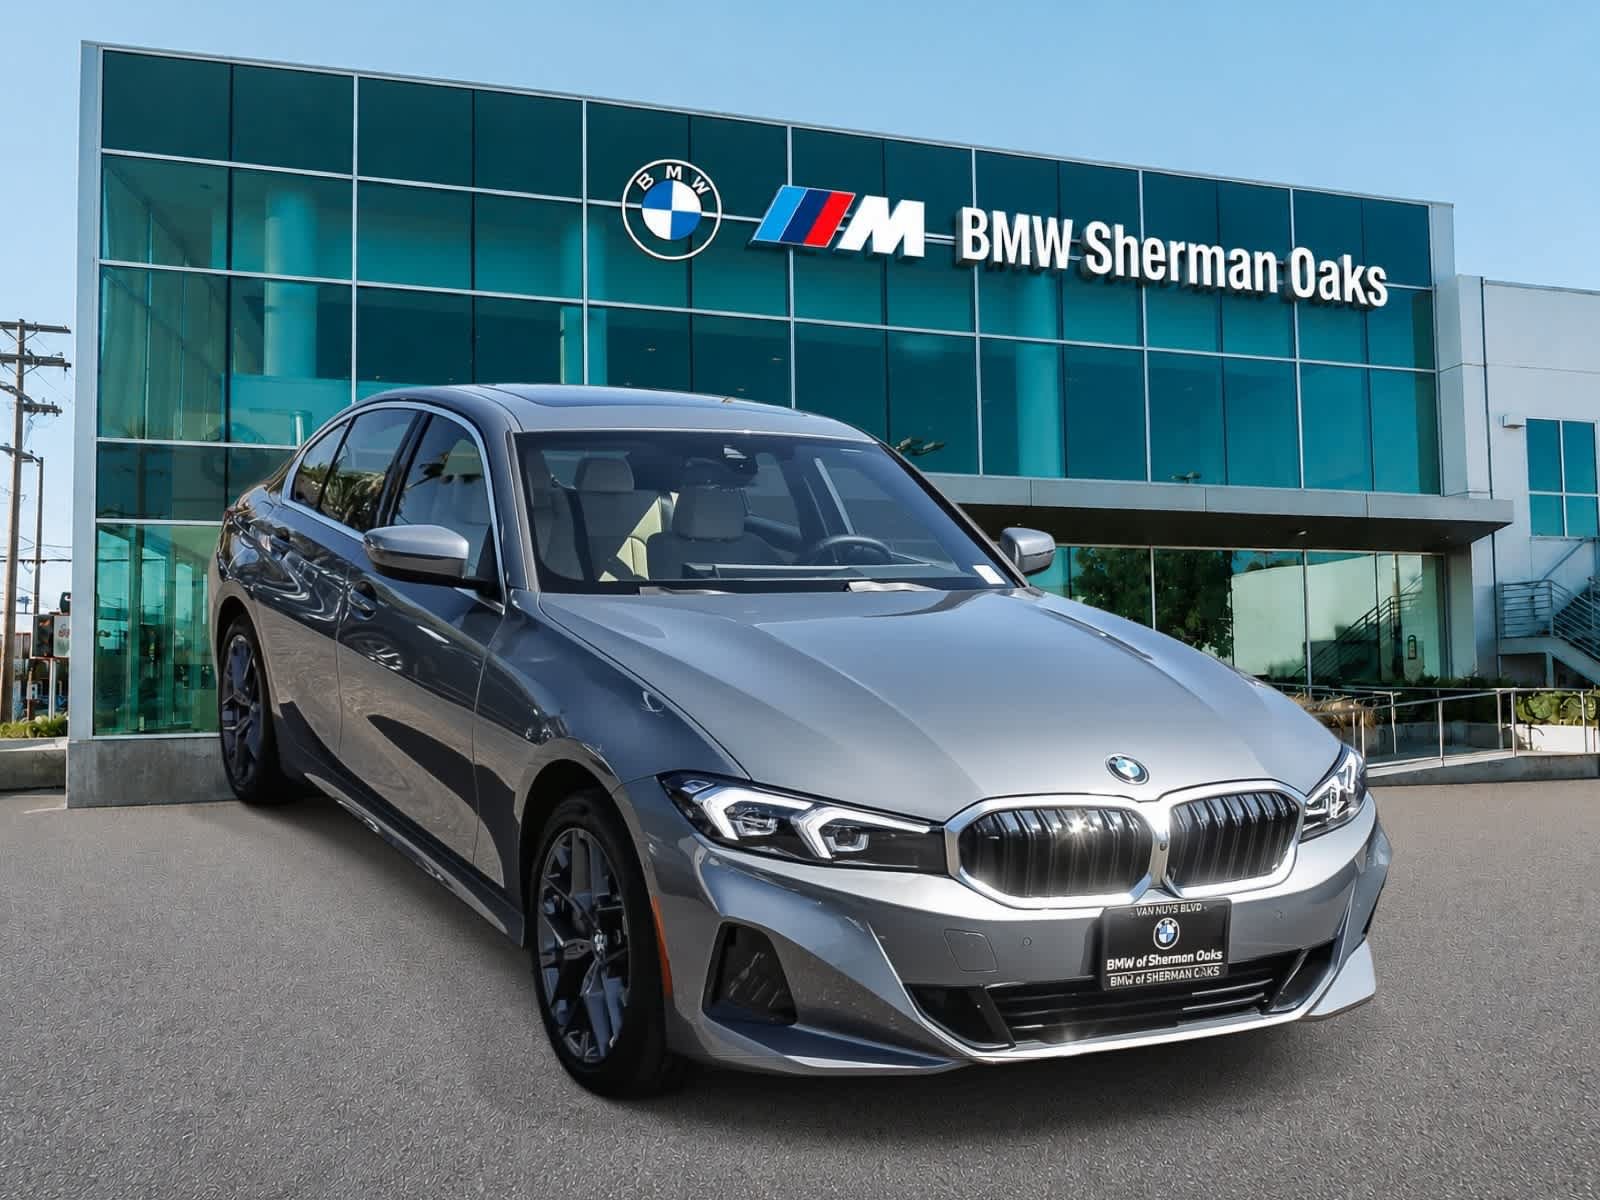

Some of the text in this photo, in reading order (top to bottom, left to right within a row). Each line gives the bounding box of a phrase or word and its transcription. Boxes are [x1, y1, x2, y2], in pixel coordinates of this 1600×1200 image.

[635, 164, 711, 195] BMW
[959, 205, 1389, 308] BMW Sherman Oaks
[1136, 902, 1202, 917] VAN NUYS BLVD
[1106, 948, 1223, 971] BMW of Sherman Oaks
[1110, 974, 1134, 987] BMW
[1135, 973, 1145, 985] of
[1146, 968, 1192, 984] SHERMAN
